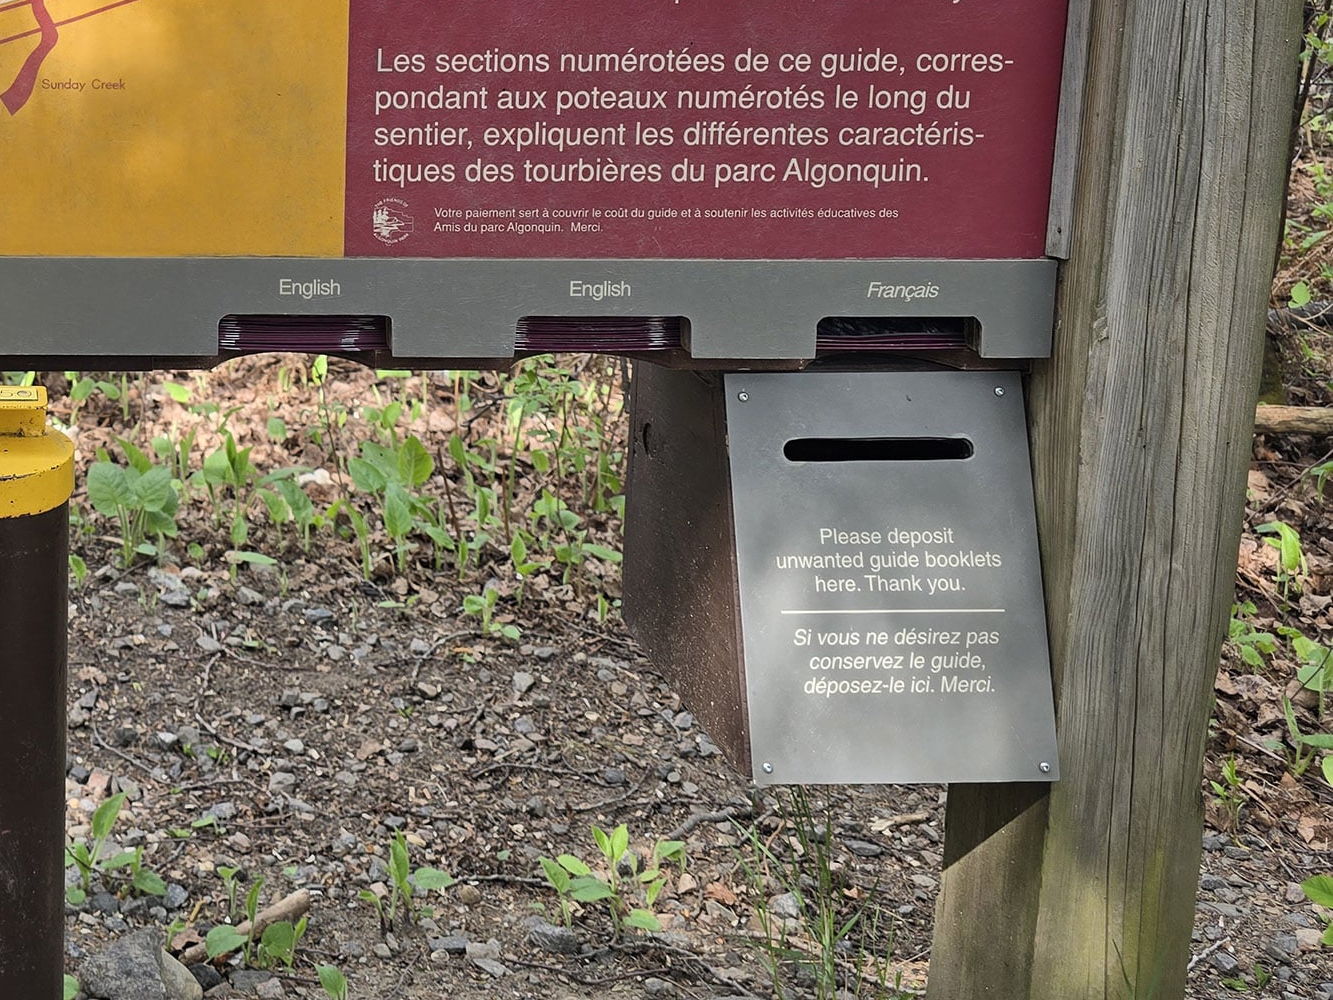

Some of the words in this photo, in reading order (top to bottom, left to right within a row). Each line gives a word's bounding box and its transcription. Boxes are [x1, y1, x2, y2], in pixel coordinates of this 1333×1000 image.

[41, 78, 86, 92] Sunday
[91, 78, 125, 90] Creek
[373, 158, 455, 188] tiques
[465, 158, 514, 182] des
[523, 158, 662, 182] tourbières
[671, 158, 705, 182] du
[715, 164, 775, 188] parc
[782, 158, 928, 188] Algonquin.
[434, 207, 462, 218] Votre
[466, 208, 515, 220] paiement
[519, 208, 539, 217] sert
[542, 207, 549, 218] à
[552, 208, 589, 217] couvrir
[592, 208, 602, 217] le
[604, 207, 628, 218] coût
[631, 207, 645, 218] du
[648, 207, 678, 220] guide
[681, 208, 691, 217] et
[694, 207, 701, 217] à
[704, 207, 748, 218] soutenir
[751, 208, 767, 218] les
[770, 208, 814, 218] activités
[817, 207, 876, 218] éducatives
[879, 208, 899, 218] des
[433, 222, 461, 232] Amis
[463, 222, 477, 232] du
[481, 224, 505, 234] parc
[507, 222, 564, 234] Algonquin.
[571, 222, 603, 232] Merci.
[280, 279, 340, 299] English
[570, 281, 631, 301] English
[867, 282, 939, 302] Français
[820, 528, 882, 544] Please
[888, 527, 954, 548] deposit
[776, 551, 864, 569] unwanted
[870, 551, 919, 572] guide
[925, 550, 1002, 567] booklets
[815, 575, 861, 592] here.
[864, 574, 922, 591] Thank
[927, 578, 965, 595] you.
[794, 629, 812, 646] Si
[818, 632, 860, 645] vous
[866, 632, 888, 645] ne
[894, 627, 961, 645] désirez
[966, 631, 999, 648] pas
[810, 656, 904, 670] conservez
[910, 652, 925, 669] le
[931, 651, 985, 673] guide,
[804, 676, 905, 698] déposez-le
[911, 676, 934, 693] ici.
[941, 675, 995, 692] Merci.
